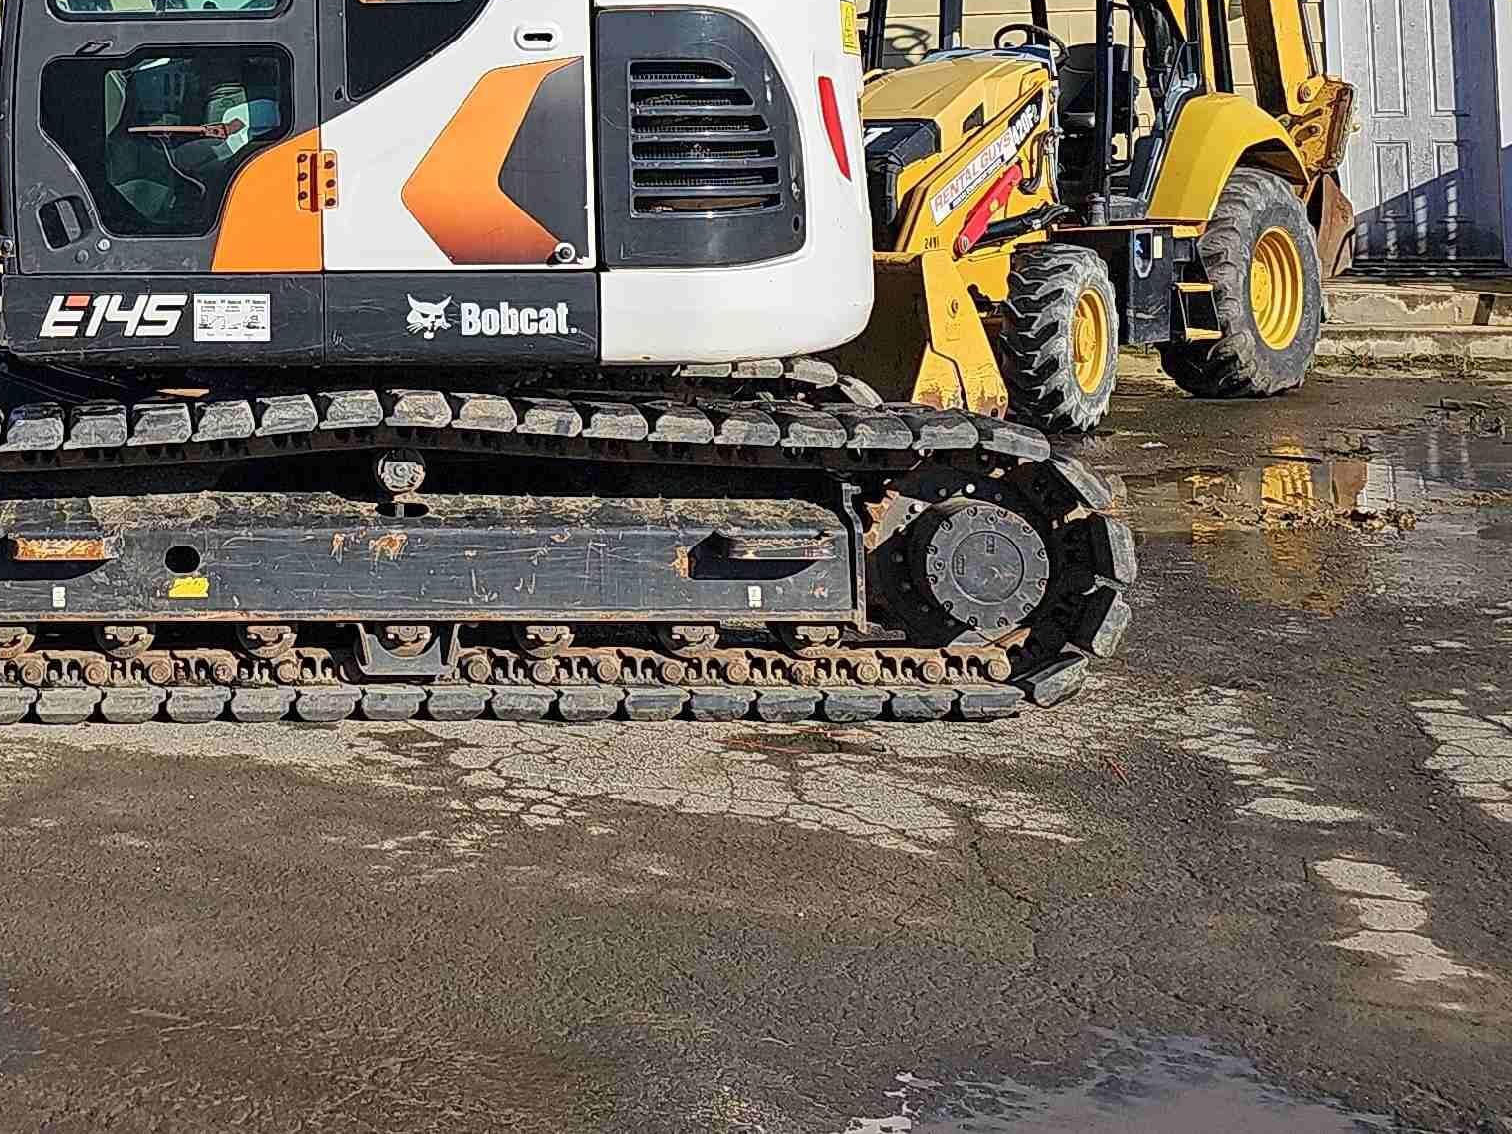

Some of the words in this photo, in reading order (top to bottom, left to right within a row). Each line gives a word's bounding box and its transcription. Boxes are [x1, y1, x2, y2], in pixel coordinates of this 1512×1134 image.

[934, 164, 979, 212] RENTAL
[979, 130, 1013, 169] GUYS
[39, 294, 189, 338] E145
[460, 301, 570, 336] Bobcat
